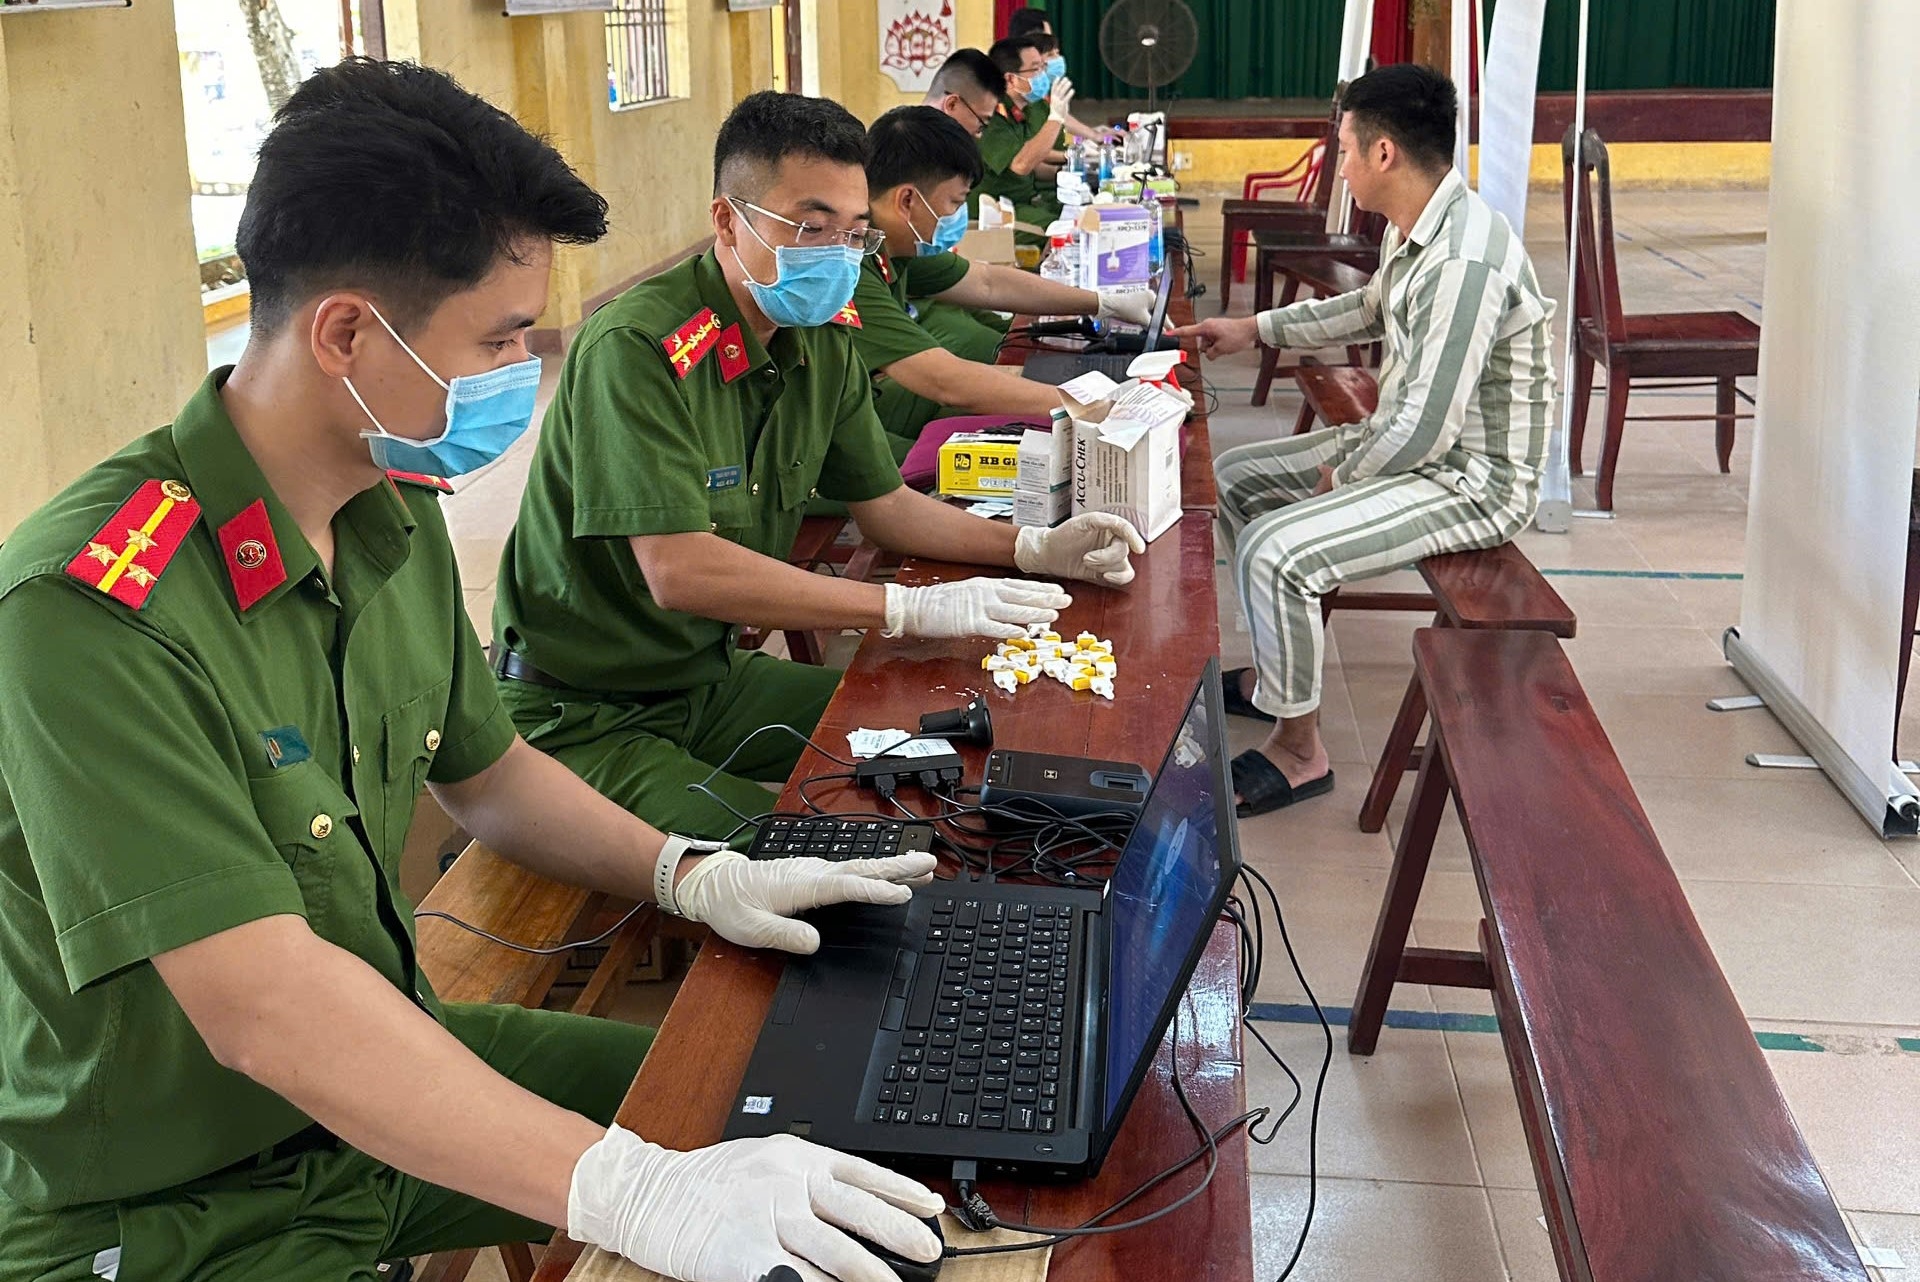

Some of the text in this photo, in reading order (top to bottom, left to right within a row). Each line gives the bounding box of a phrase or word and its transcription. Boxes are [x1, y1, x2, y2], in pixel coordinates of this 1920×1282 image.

[979, 456, 999, 465] HB
[1002, 457, 1018, 466] Gl
[1075, 437, 1087, 508] ACCU-CHEK
